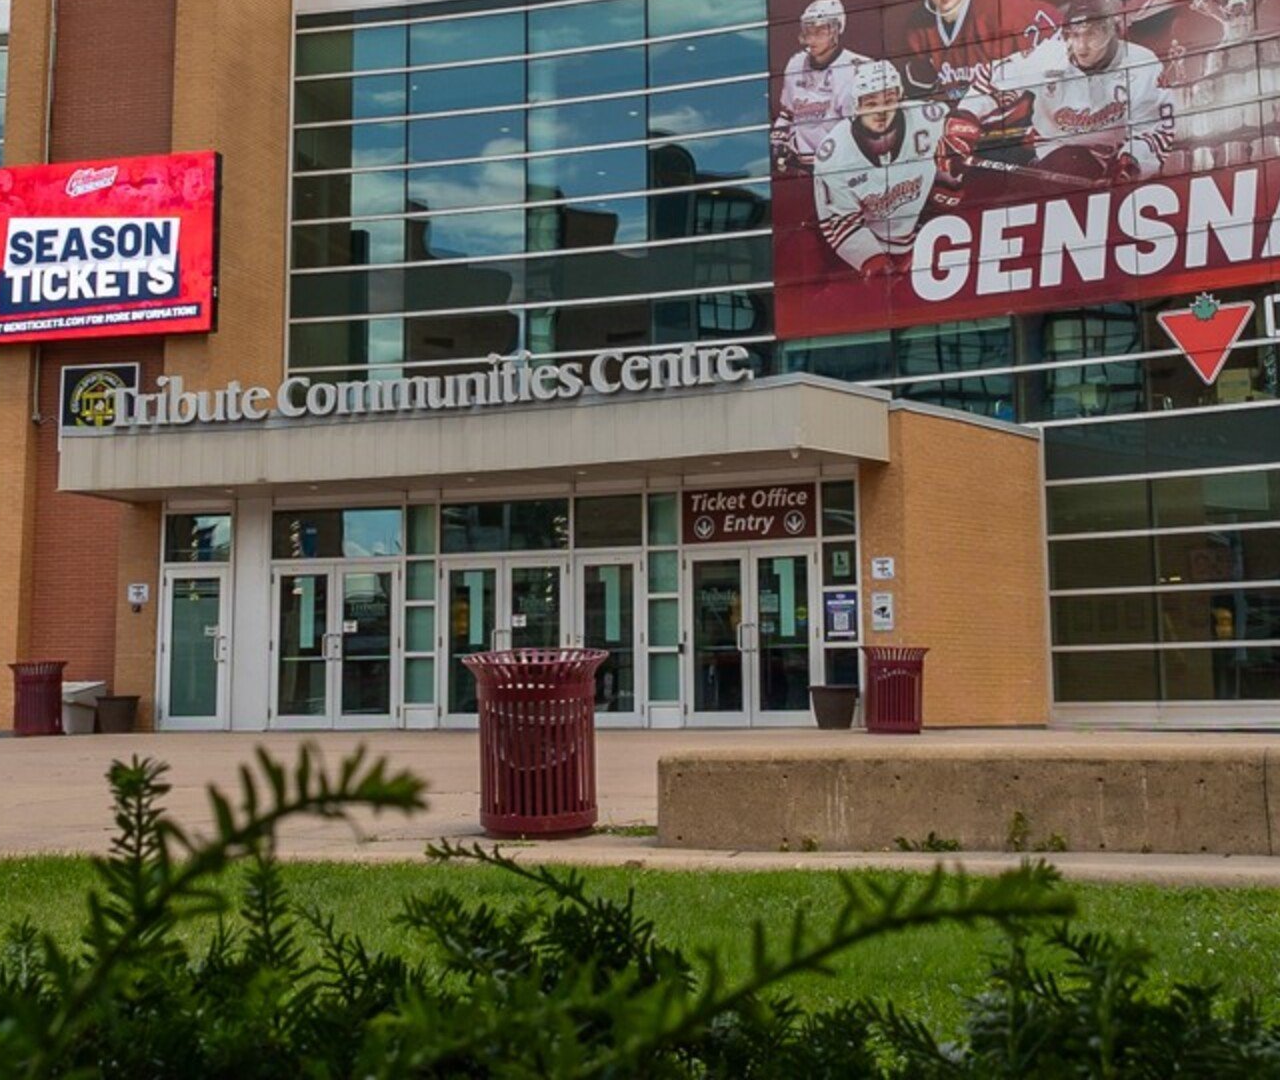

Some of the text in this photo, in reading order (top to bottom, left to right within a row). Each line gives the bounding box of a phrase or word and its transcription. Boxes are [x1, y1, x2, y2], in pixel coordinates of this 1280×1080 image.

[9, 220, 171, 266] SEASON
[5, 258, 175, 304] TICKETS
[86, 315, 104, 326] FOR
[104, 374, 270, 428] Tribute
[276, 350, 584, 418] Communities
[589, 344, 751, 395] Centre
[690, 486, 808, 513] Ticket Office
[723, 513, 775, 535] Entry
